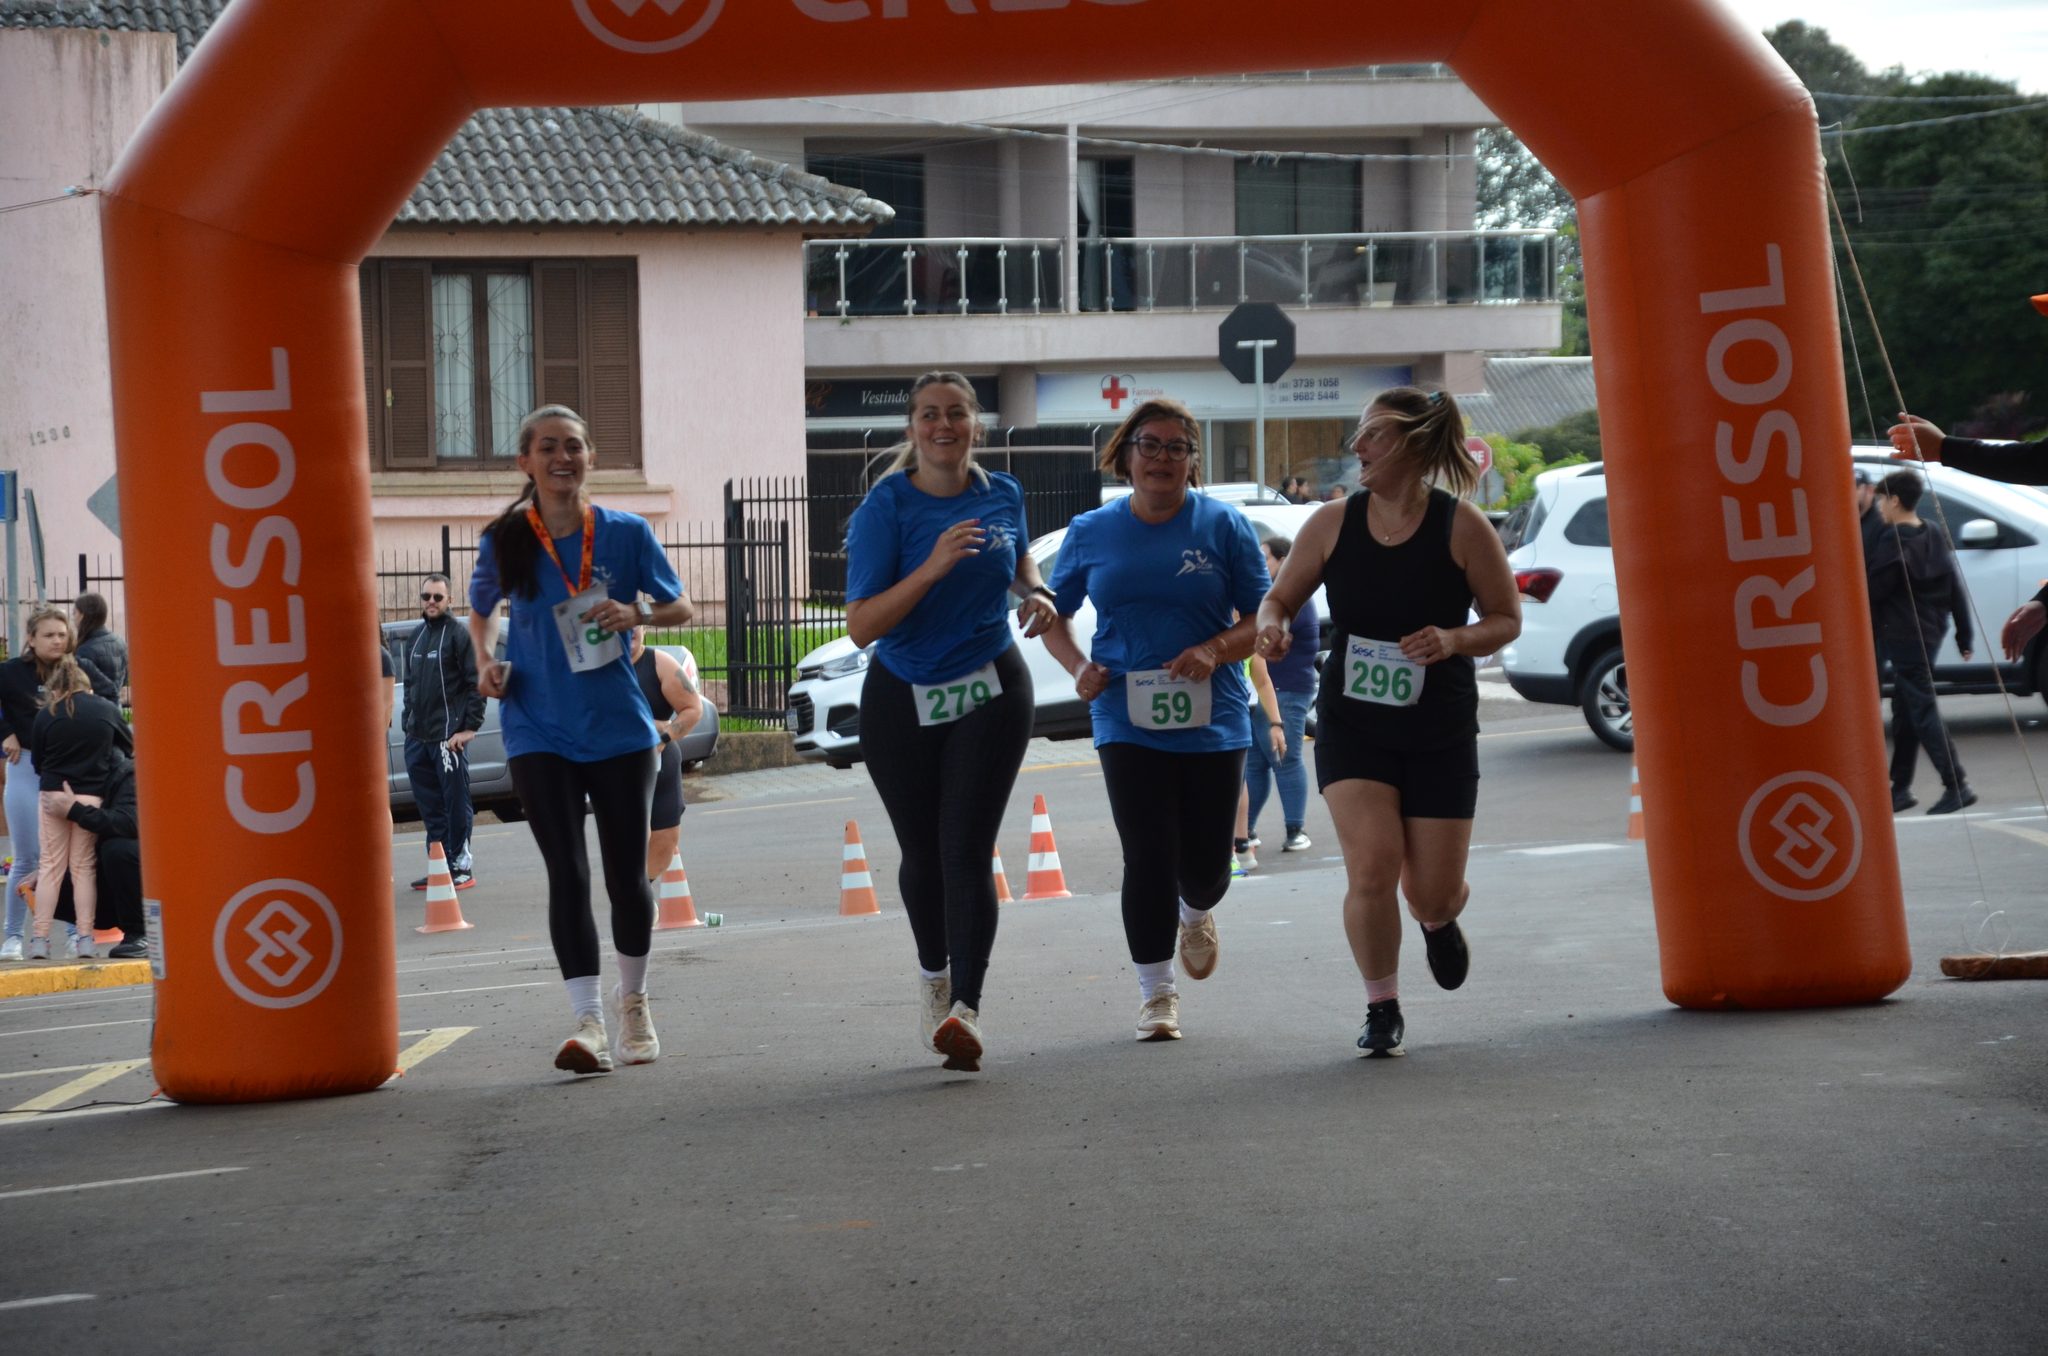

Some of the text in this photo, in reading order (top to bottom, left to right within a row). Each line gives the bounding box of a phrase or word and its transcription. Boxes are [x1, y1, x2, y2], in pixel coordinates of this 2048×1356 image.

[861, 389, 910, 405] Vestindo
[1700, 243, 1829, 727] CRESOL
[200, 346, 316, 835] CRESOL
[926, 680, 992, 720] 279
[1350, 660, 1413, 702] 296
[1152, 691, 1192, 725] 59
